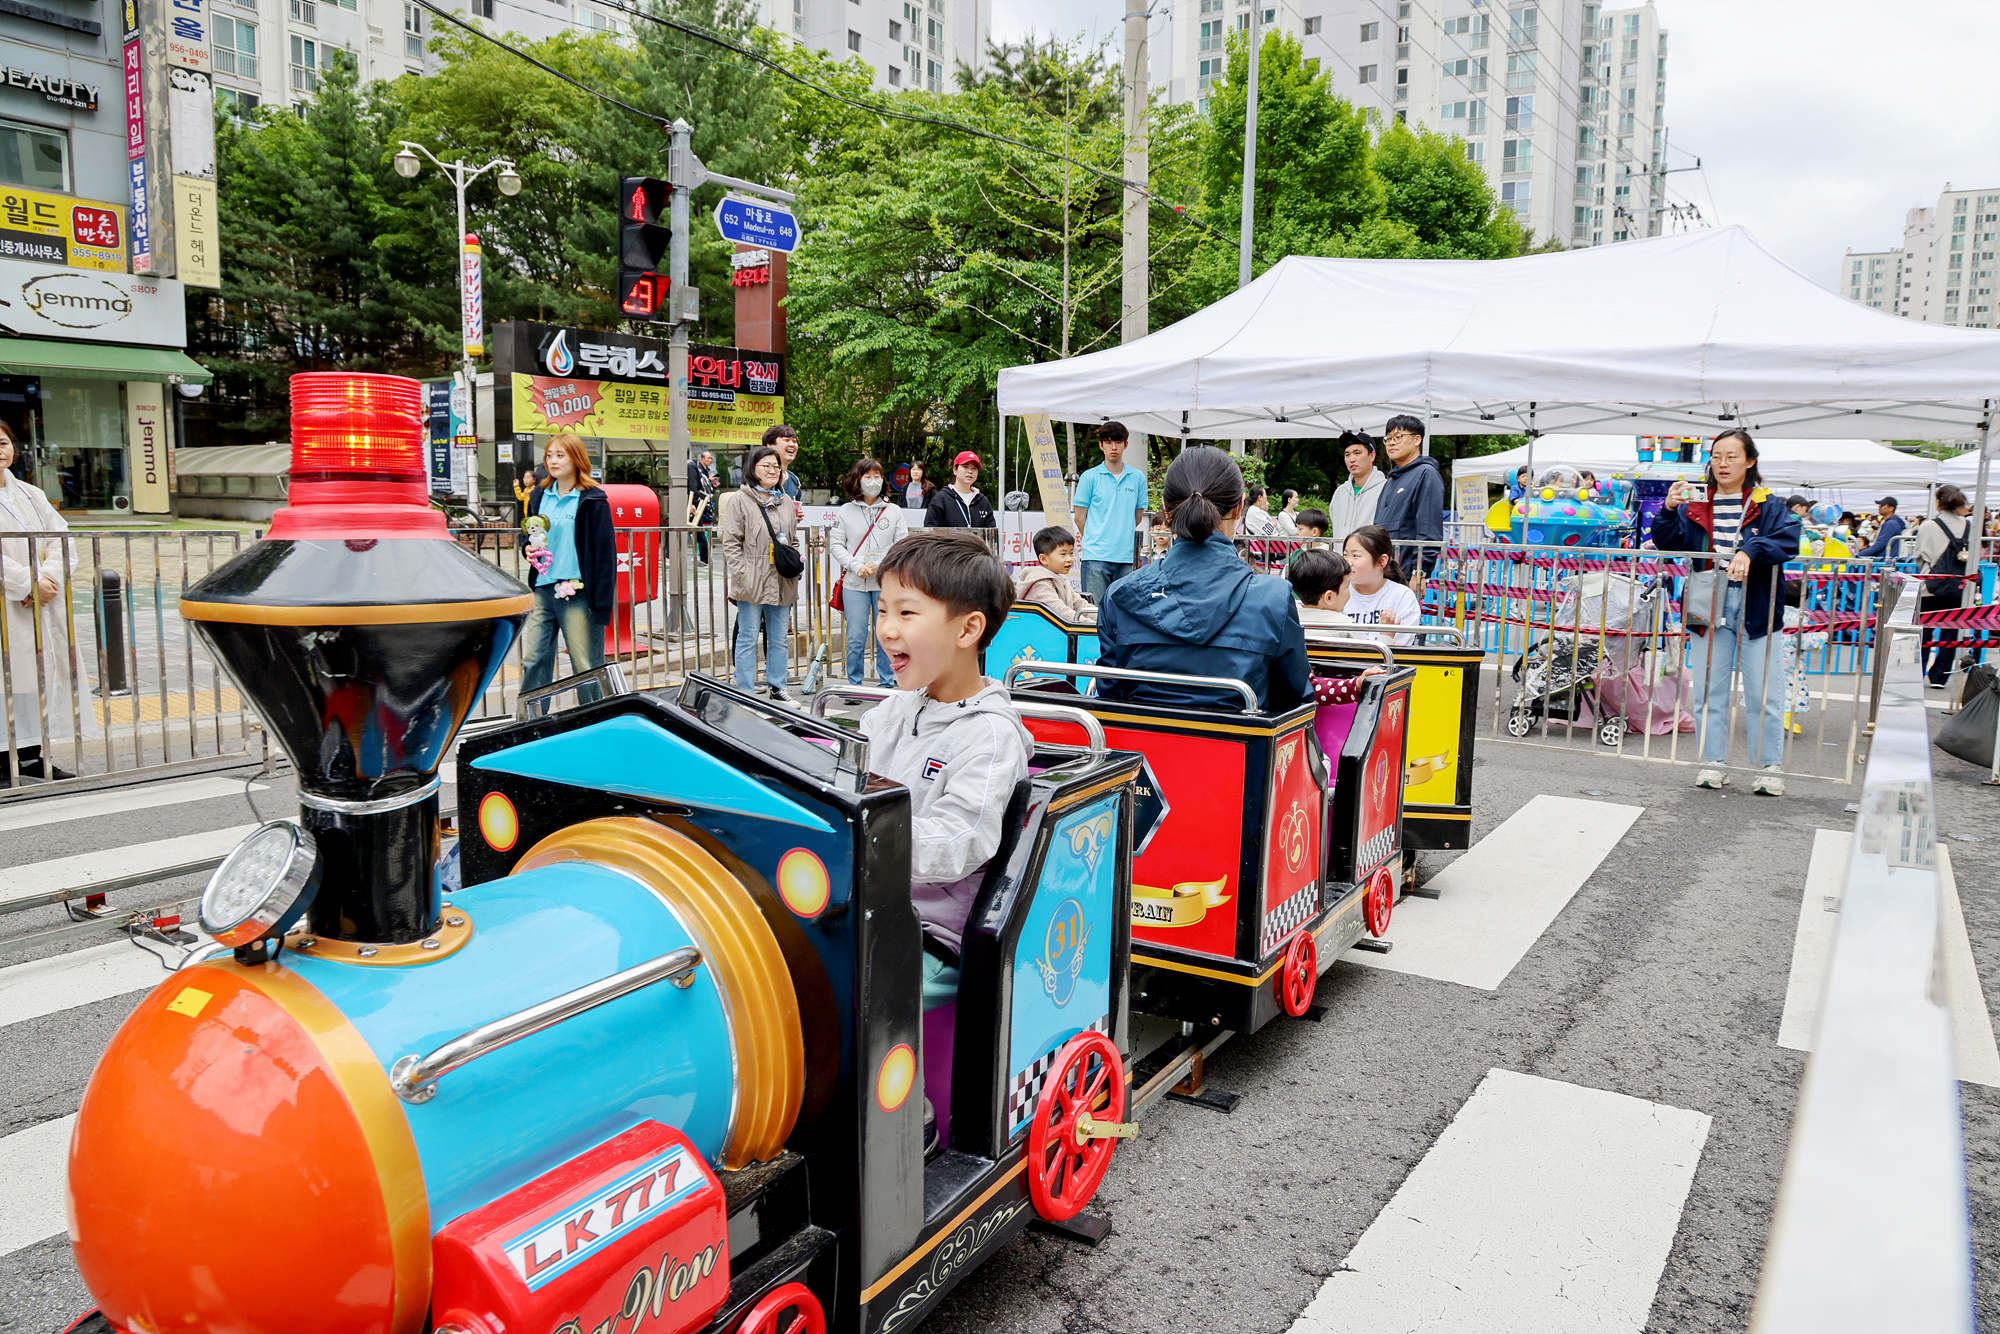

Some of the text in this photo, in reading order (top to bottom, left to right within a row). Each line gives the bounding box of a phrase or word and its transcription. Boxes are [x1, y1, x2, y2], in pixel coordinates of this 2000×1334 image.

[169, 42, 209, 60] 956-0405
[126, 46, 143, 145] 체리네일
[132, 161, 147, 239] 부동산
[2, 195, 60, 228] 월드
[78, 212, 111, 227] 미소
[724, 207, 793, 238] 652 마들로 648
[743, 221, 775, 236] Madeul-ro
[78, 226, 116, 244] 반찬
[72, 247, 122, 263] 955-8919
[730, 267, 769, 287] 사우나
[131, 284, 158, 295] SHOP
[33, 289, 130, 313] jemma
[578, 342, 666, 378] 루하스
[746, 360, 779, 382] 24시
[543, 383, 576, 400] 평일목욕
[749, 378, 777, 394] 찜질방
[615, 388, 636, 404] 평일
[639, 390, 660, 405] 목욕
[135, 404, 157, 412] SHOP
[543, 394, 592, 419] 10,000
[618, 407, 646, 419] 조조요금
[138, 417, 157, 485] jemma
[822, 511, 837, 521] dob
[1135, 786, 1152, 797] RK
[1131, 902, 1173, 923] RAIN
[1052, 913, 1079, 960] 31
